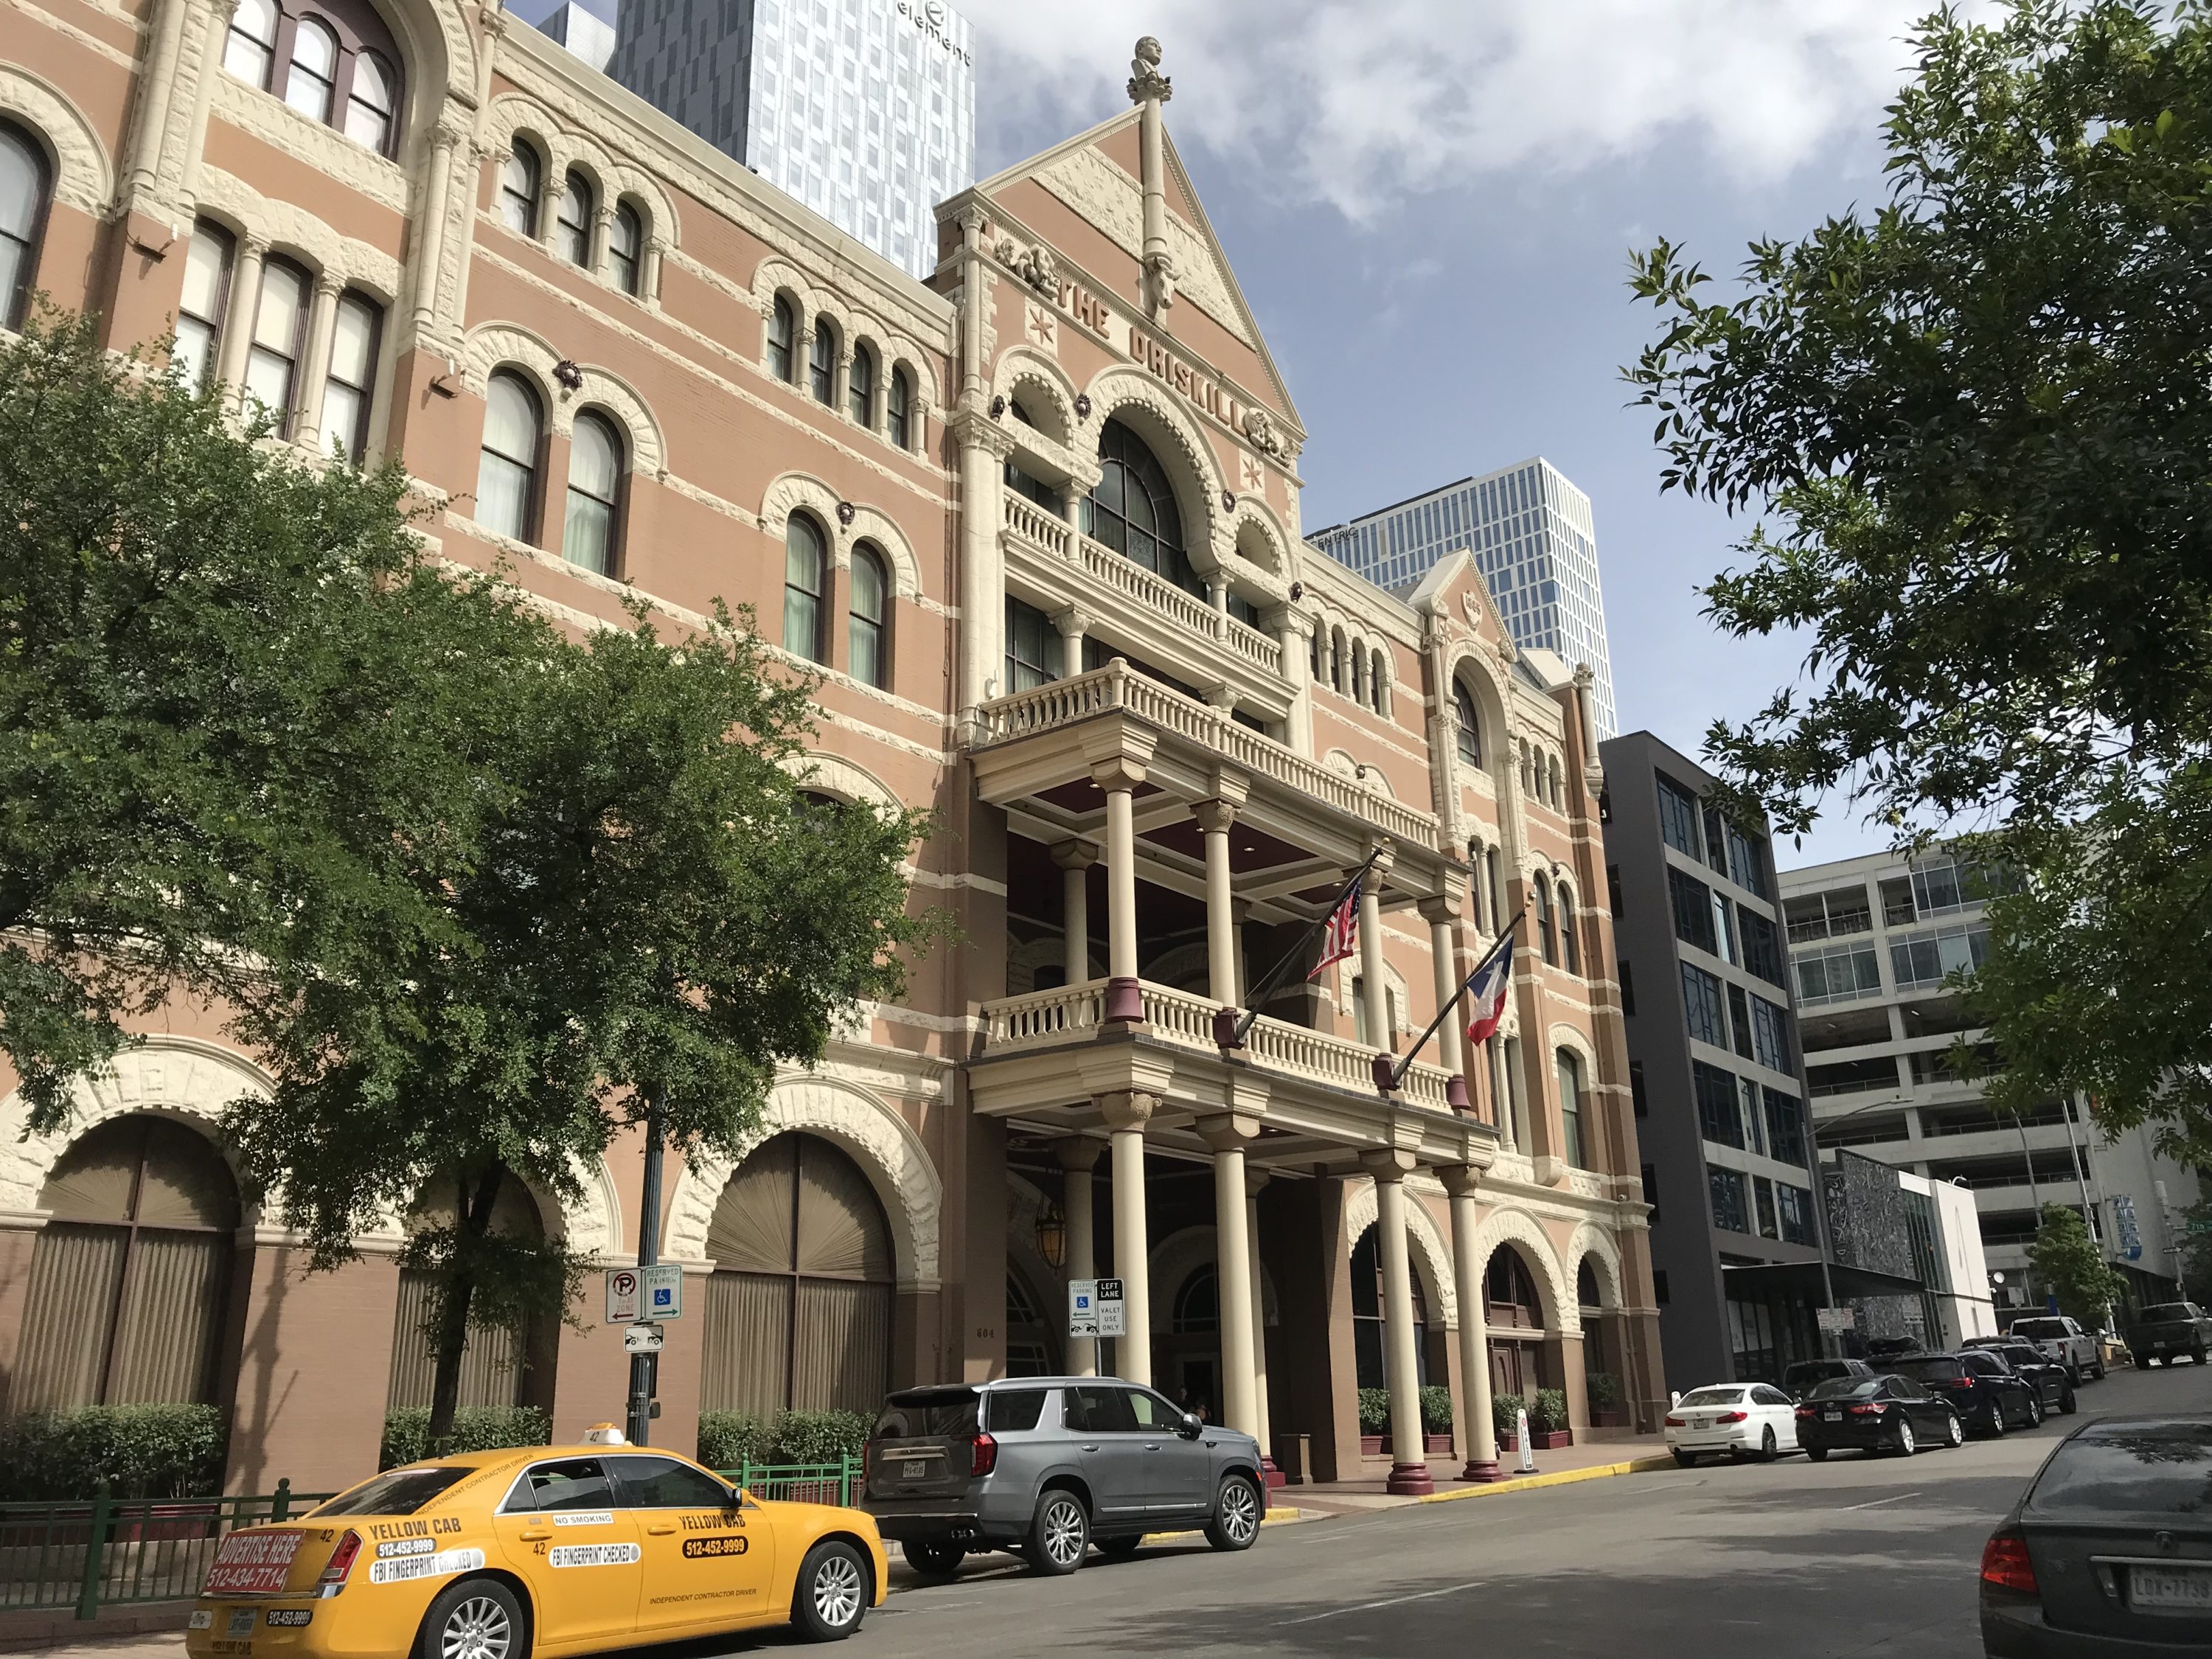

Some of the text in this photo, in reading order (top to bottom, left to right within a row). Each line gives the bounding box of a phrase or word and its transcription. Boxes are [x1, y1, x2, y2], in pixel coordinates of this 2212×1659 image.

[897, 1, 971, 67] element
[1057, 274, 1247, 437] THE DRISKILL
[616, 1304, 634, 1312] ZONE
[977, 1328, 994, 1338] 604
[589, 1431, 599, 1442] 42
[466, 1464, 511, 1489] CONTRACTOR
[511, 1454, 533, 1467] DRIVER
[571, 1515, 611, 1523] SMOKING
[678, 1514, 746, 1531] YELLOW CAB
[320, 1528, 334, 1543] 42
[369, 1517, 462, 1540] YELLOW CAB
[216, 1535, 301, 1564] ADVERTISE HERE
[379, 1540, 434, 1557] 512-452-9999
[533, 1543, 546, 1556] 42
[553, 1545, 630, 1566] FBI FINGERPRINT CHECKED
[686, 1539, 745, 1556] 512-452-9999
[206, 1568, 288, 1587] 512-434-7714
[375, 1562, 386, 1582] FBI
[389, 1556, 436, 1580] FINGERPRINT
[650, 1588, 757, 1604] INDEPENDENT CONTRACTOR DRIVER
[269, 1612, 310, 1624] 512-452-9999
